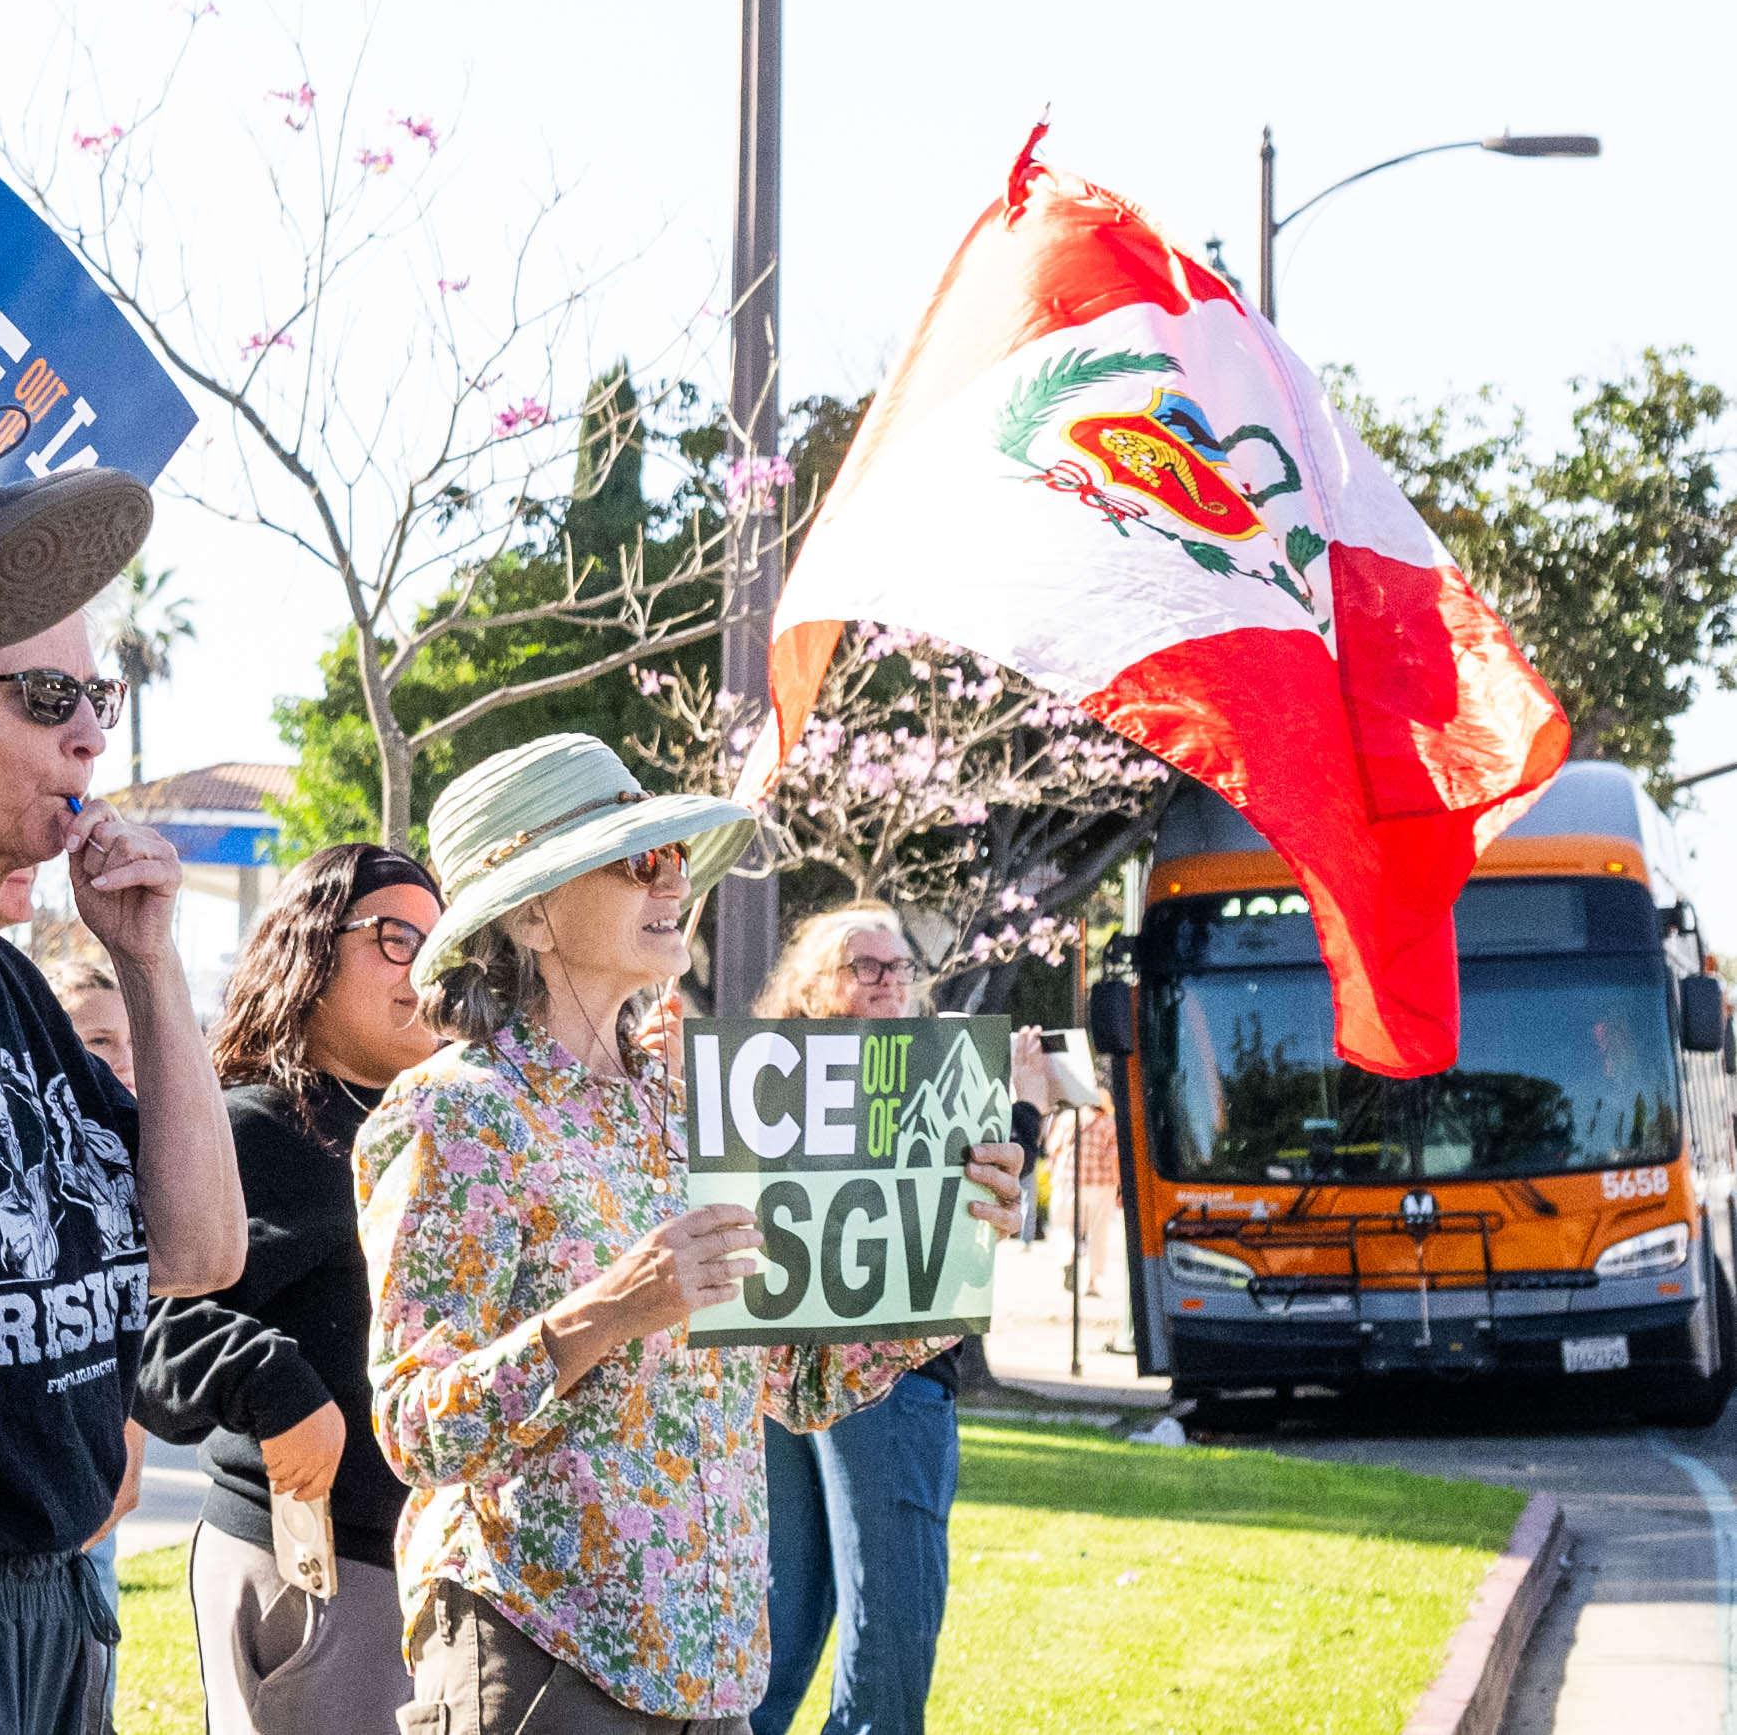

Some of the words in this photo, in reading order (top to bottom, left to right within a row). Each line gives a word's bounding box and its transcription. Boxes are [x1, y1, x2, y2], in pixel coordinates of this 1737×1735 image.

[14, 357, 69, 424] OUT
[693, 1031, 861, 1159] ICE
[862, 1034, 914, 1094] OUT
[867, 1098, 901, 1158] OF
[1602, 1166, 1669, 1200] 5658
[743, 1176, 963, 1320] SGV
